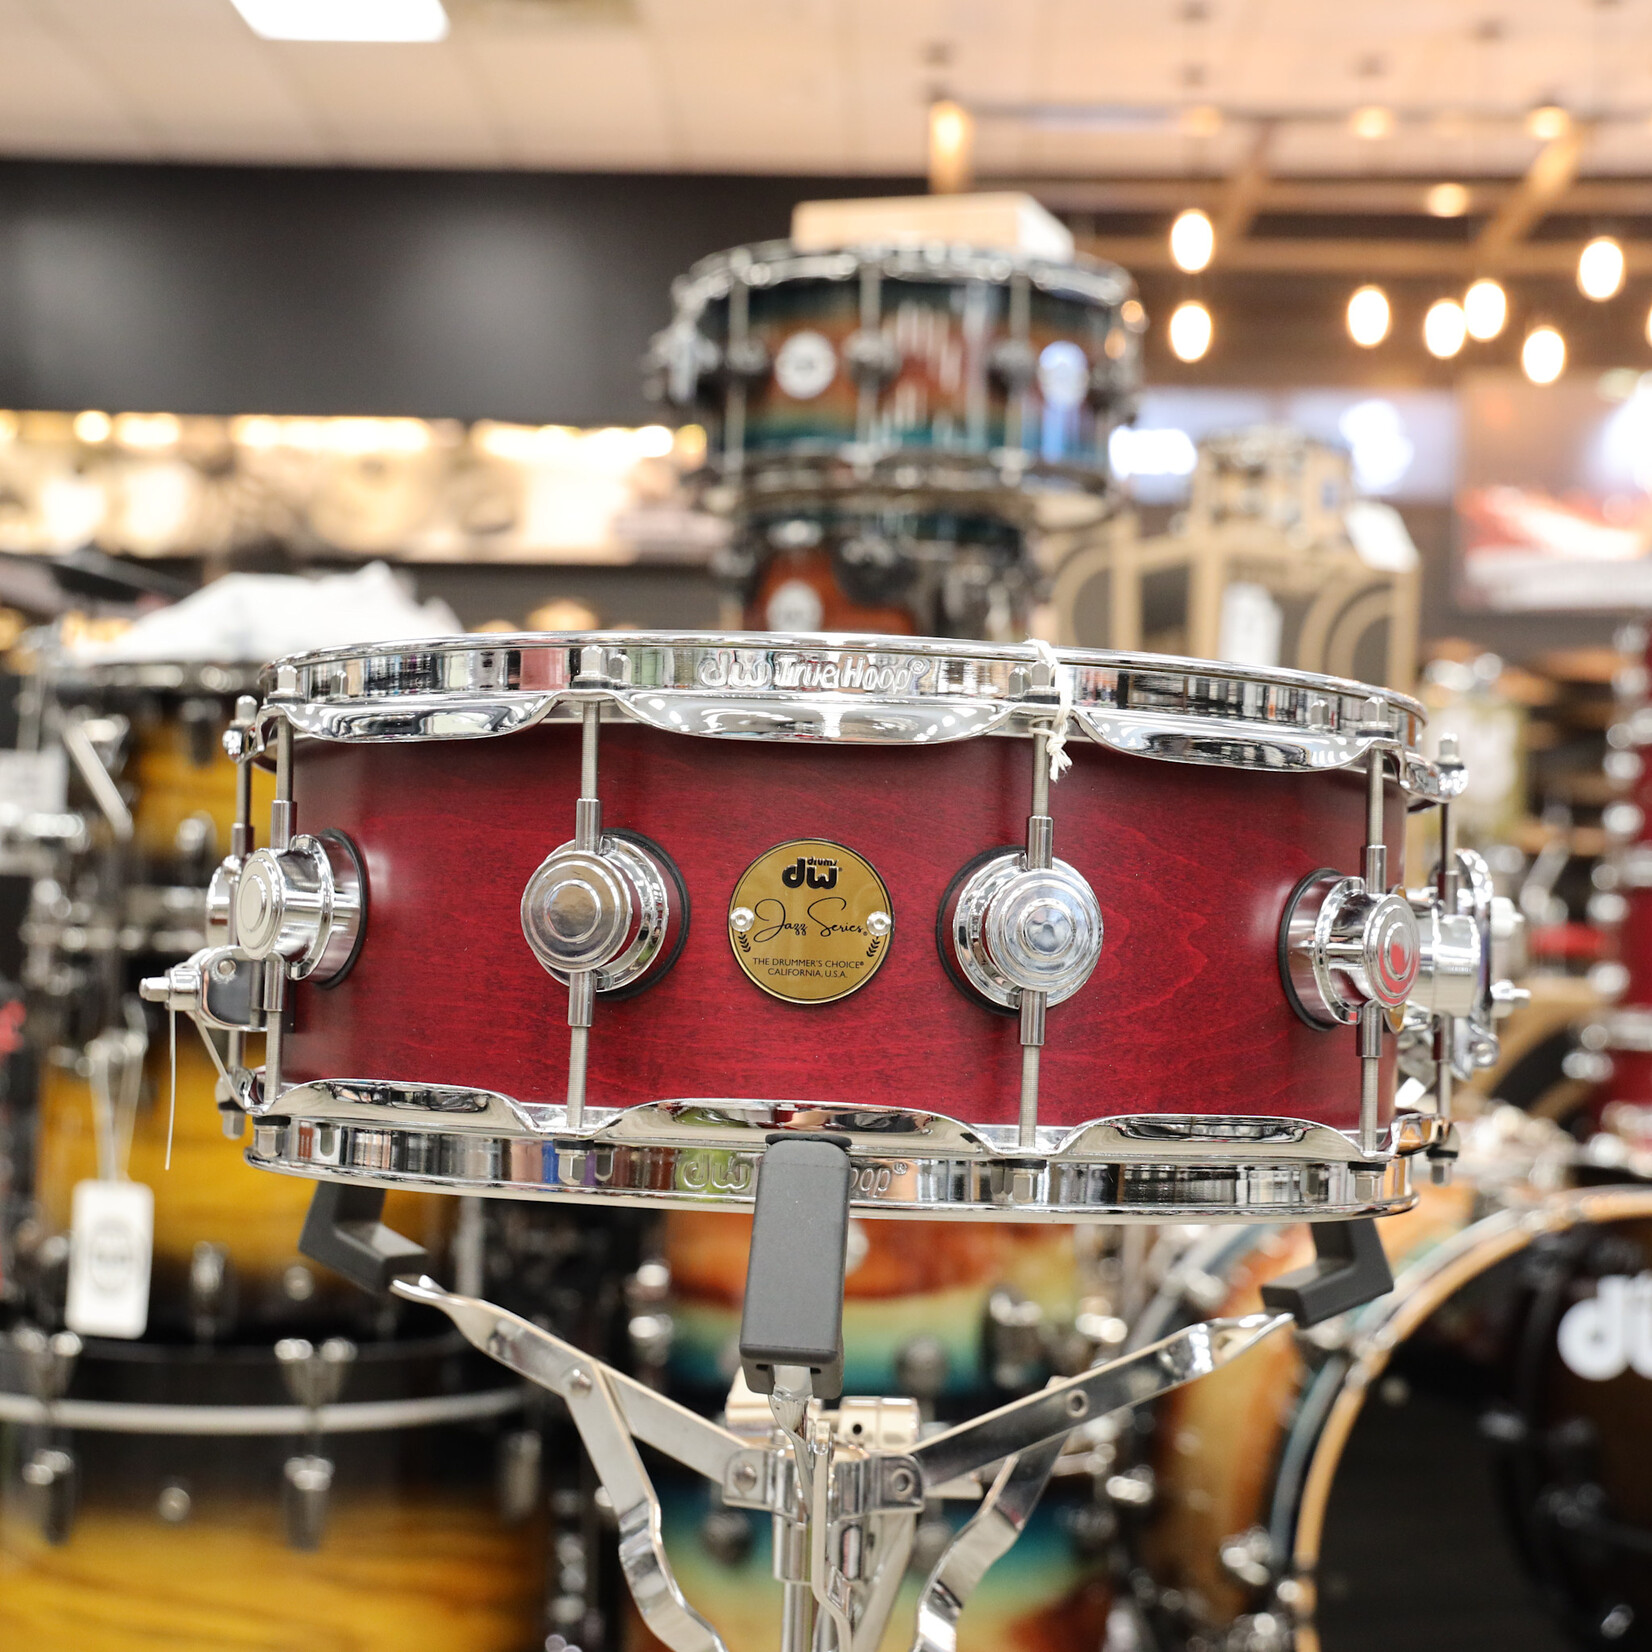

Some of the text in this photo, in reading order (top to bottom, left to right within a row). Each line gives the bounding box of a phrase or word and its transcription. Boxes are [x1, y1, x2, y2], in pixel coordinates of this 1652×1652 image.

[699, 650, 770, 688] dw
[781, 857, 838, 890] dw
[807, 856, 838, 866] drums
[753, 896, 864, 943] Jazz Series
[752, 957, 860, 969] THE DRUMMER'S CHOICE
[683, 1152, 750, 1190] dw
